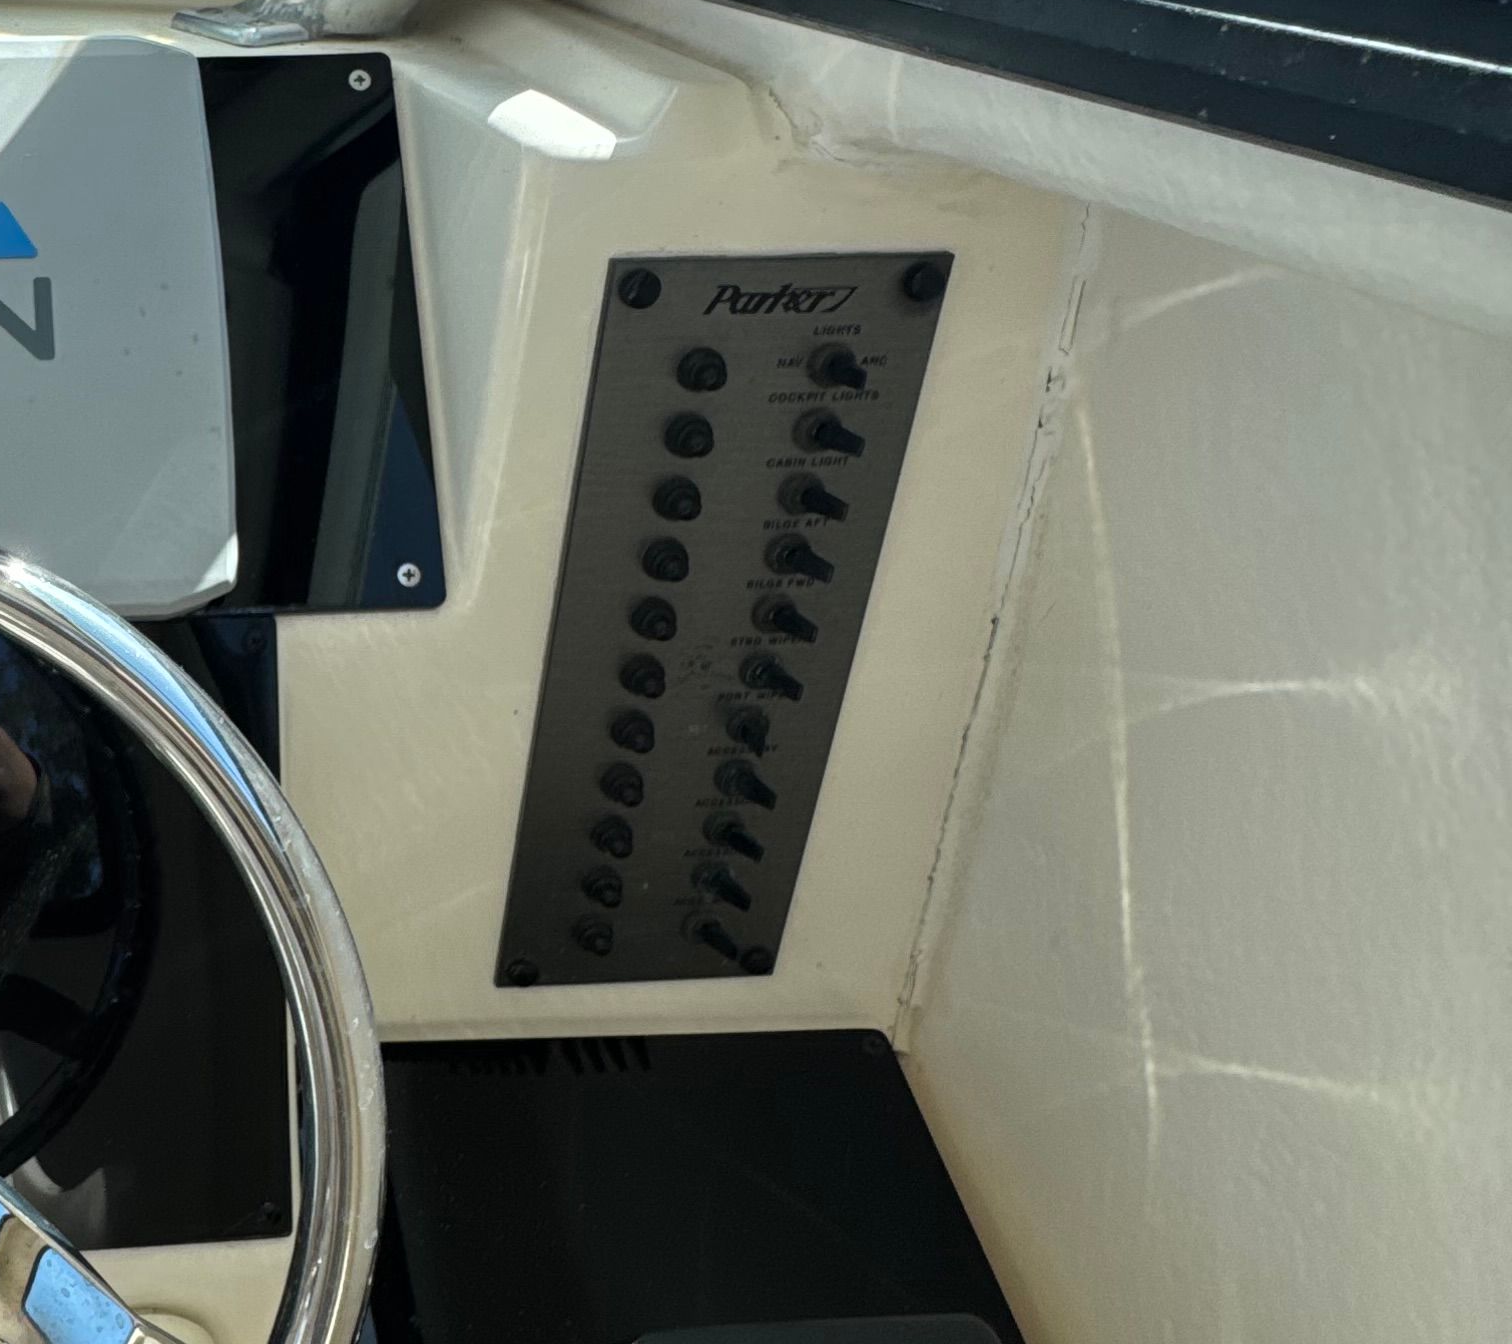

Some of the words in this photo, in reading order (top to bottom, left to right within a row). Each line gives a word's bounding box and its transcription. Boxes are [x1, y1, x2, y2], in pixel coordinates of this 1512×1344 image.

[703, 283, 858, 315] Parker
[813, 324, 862, 336] LIGHTS
[776, 355, 803, 368] NAV
[768, 392, 826, 403] COCKPIT
[832, 391, 879, 402] LIGHTS
[766, 458, 806, 468] CABIN
[811, 456, 848, 467] LIGHT
[763, 520, 800, 530] BILGE
[804, 518, 829, 528] AFT
[747, 579, 782, 590] BILGE
[787, 577, 815, 588] FWD
[718, 692, 750, 702] PORT
